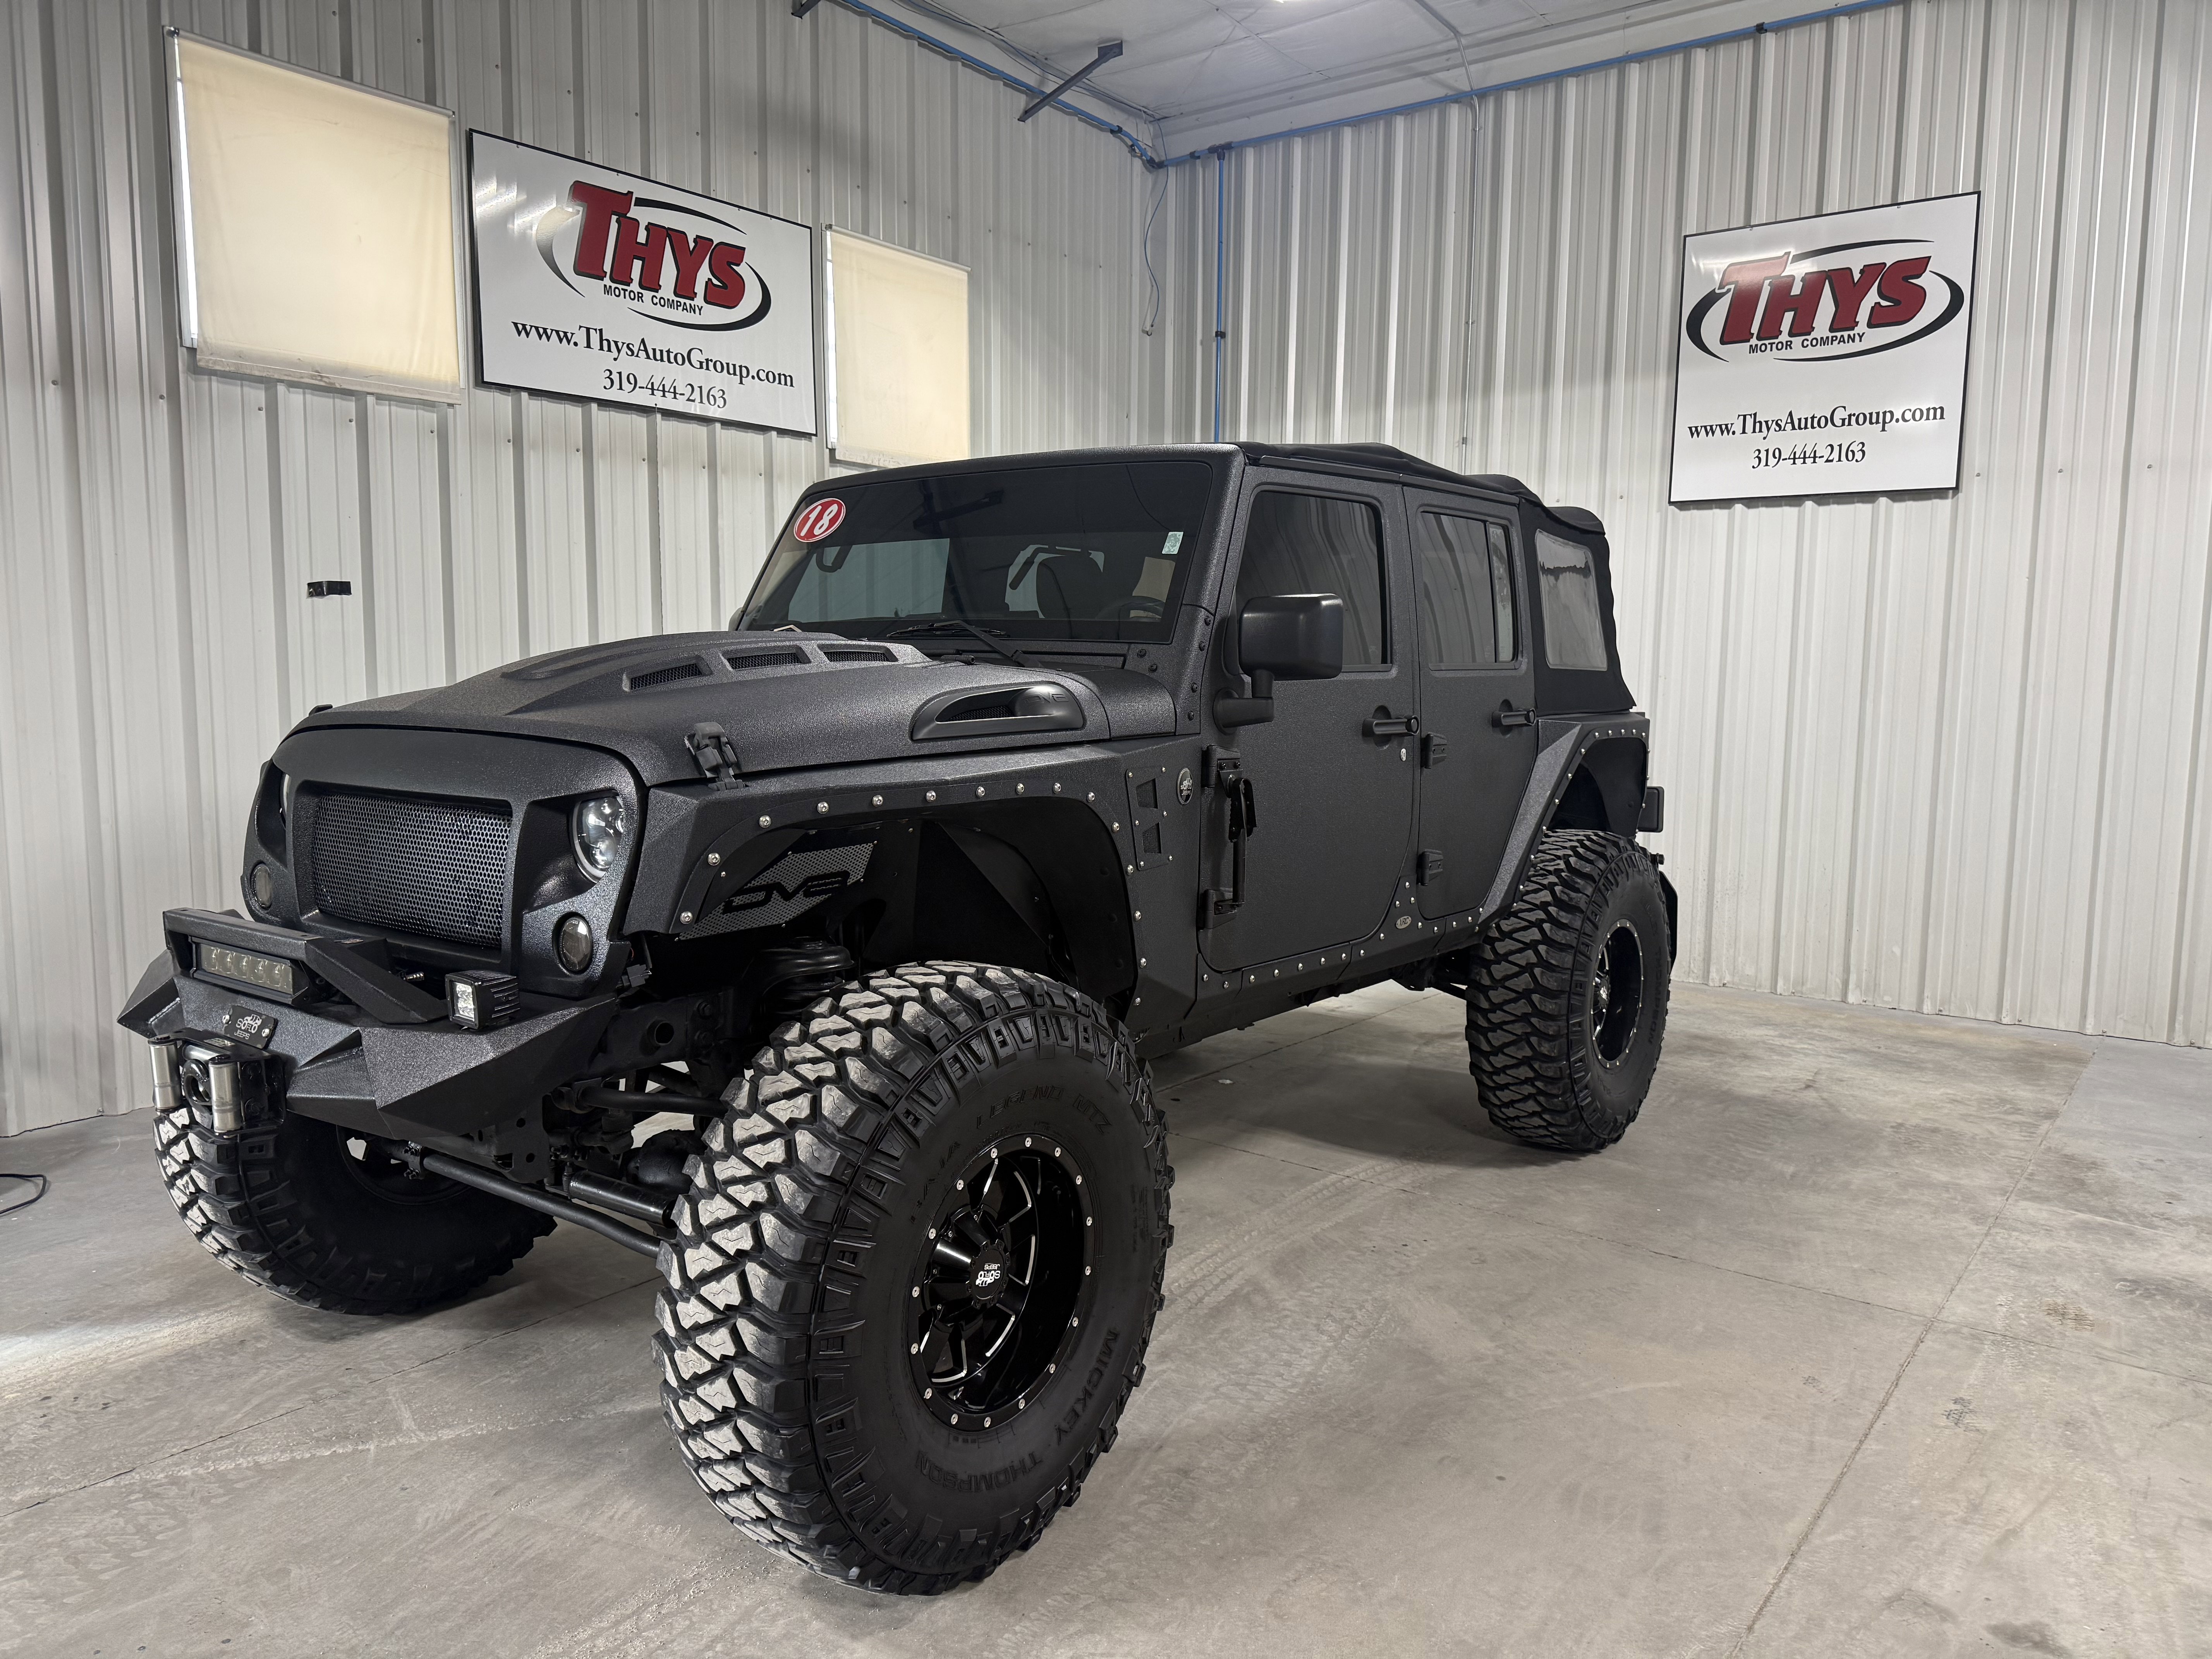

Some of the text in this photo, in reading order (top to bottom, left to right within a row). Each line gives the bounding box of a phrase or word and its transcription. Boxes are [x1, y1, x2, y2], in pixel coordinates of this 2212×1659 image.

[603, 284, 704, 316] MOTOR COMPANY
[511, 321, 795, 388] www.ThysAutoGroup.com
[1748, 332, 1866, 354] MOTOR COMPANY
[603, 369, 727, 409] 319-444-2163
[1688, 405, 1945, 440] www.ThysAutoGroup.com
[1752, 440, 1866, 469] 319-444-2163
[800, 503, 838, 536] 18
[977, 1084, 1066, 1129] LEGEND
[1072, 1093, 1112, 1135] MTZ
[915, 1328, 1120, 1493] MICKEY THOMPSON
